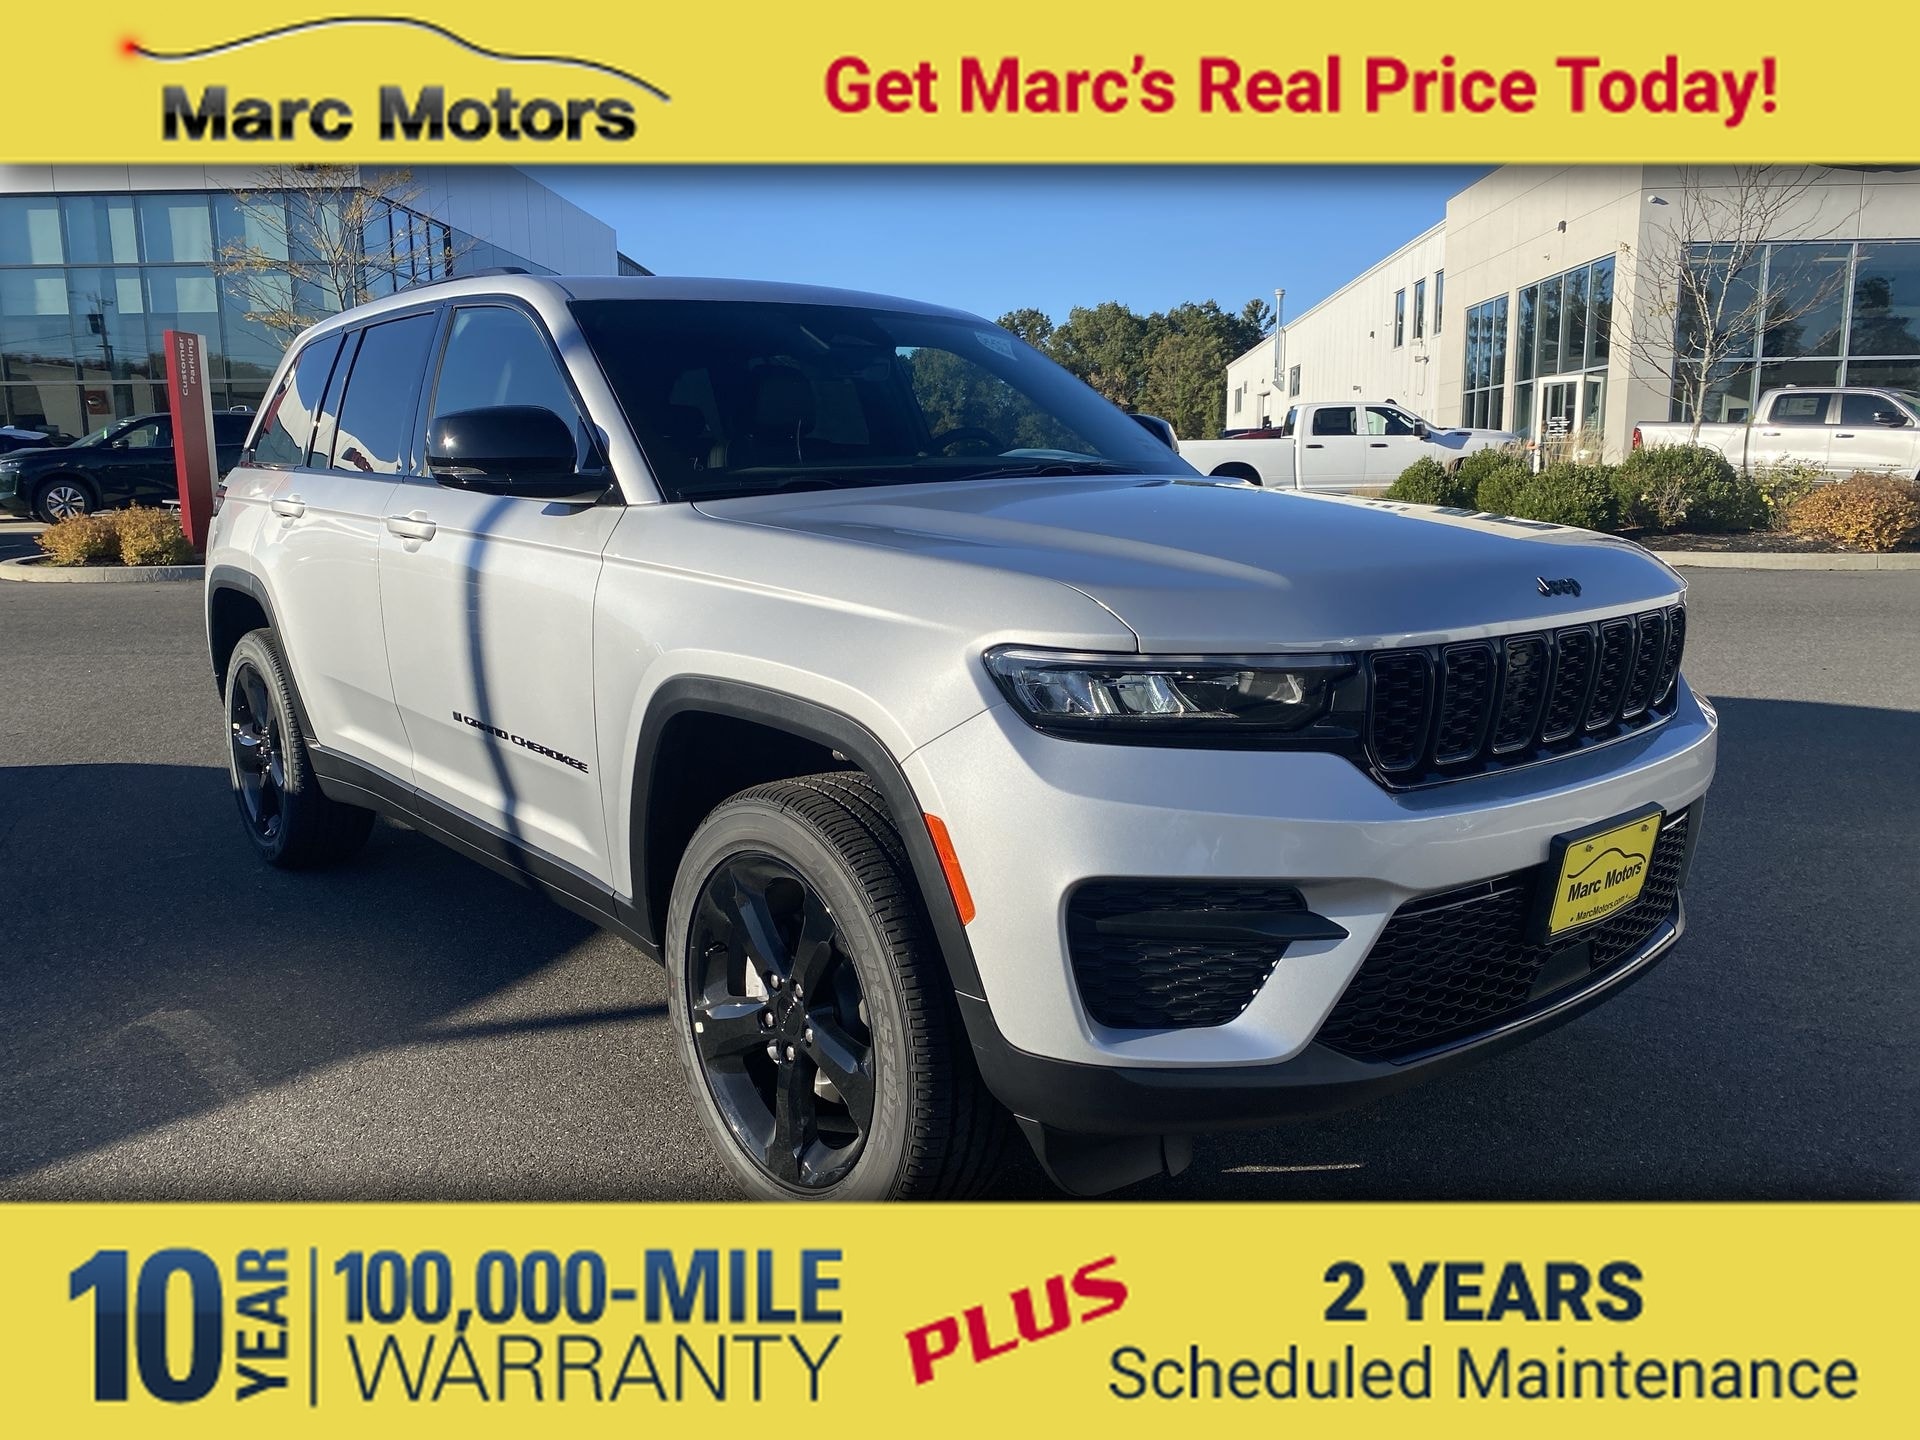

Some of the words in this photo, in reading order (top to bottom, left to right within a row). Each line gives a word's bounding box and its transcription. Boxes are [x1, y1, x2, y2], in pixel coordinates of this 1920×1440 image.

[178, 337, 189, 396] Customer
[187, 338, 197, 384] Parking
[1536, 576, 1582, 597] Jeep
[463, 715, 509, 740] GRAND
[511, 734, 589, 774] CHEROKEE
[1567, 879, 1602, 902] Marc
[1604, 862, 1643, 889] Motors
